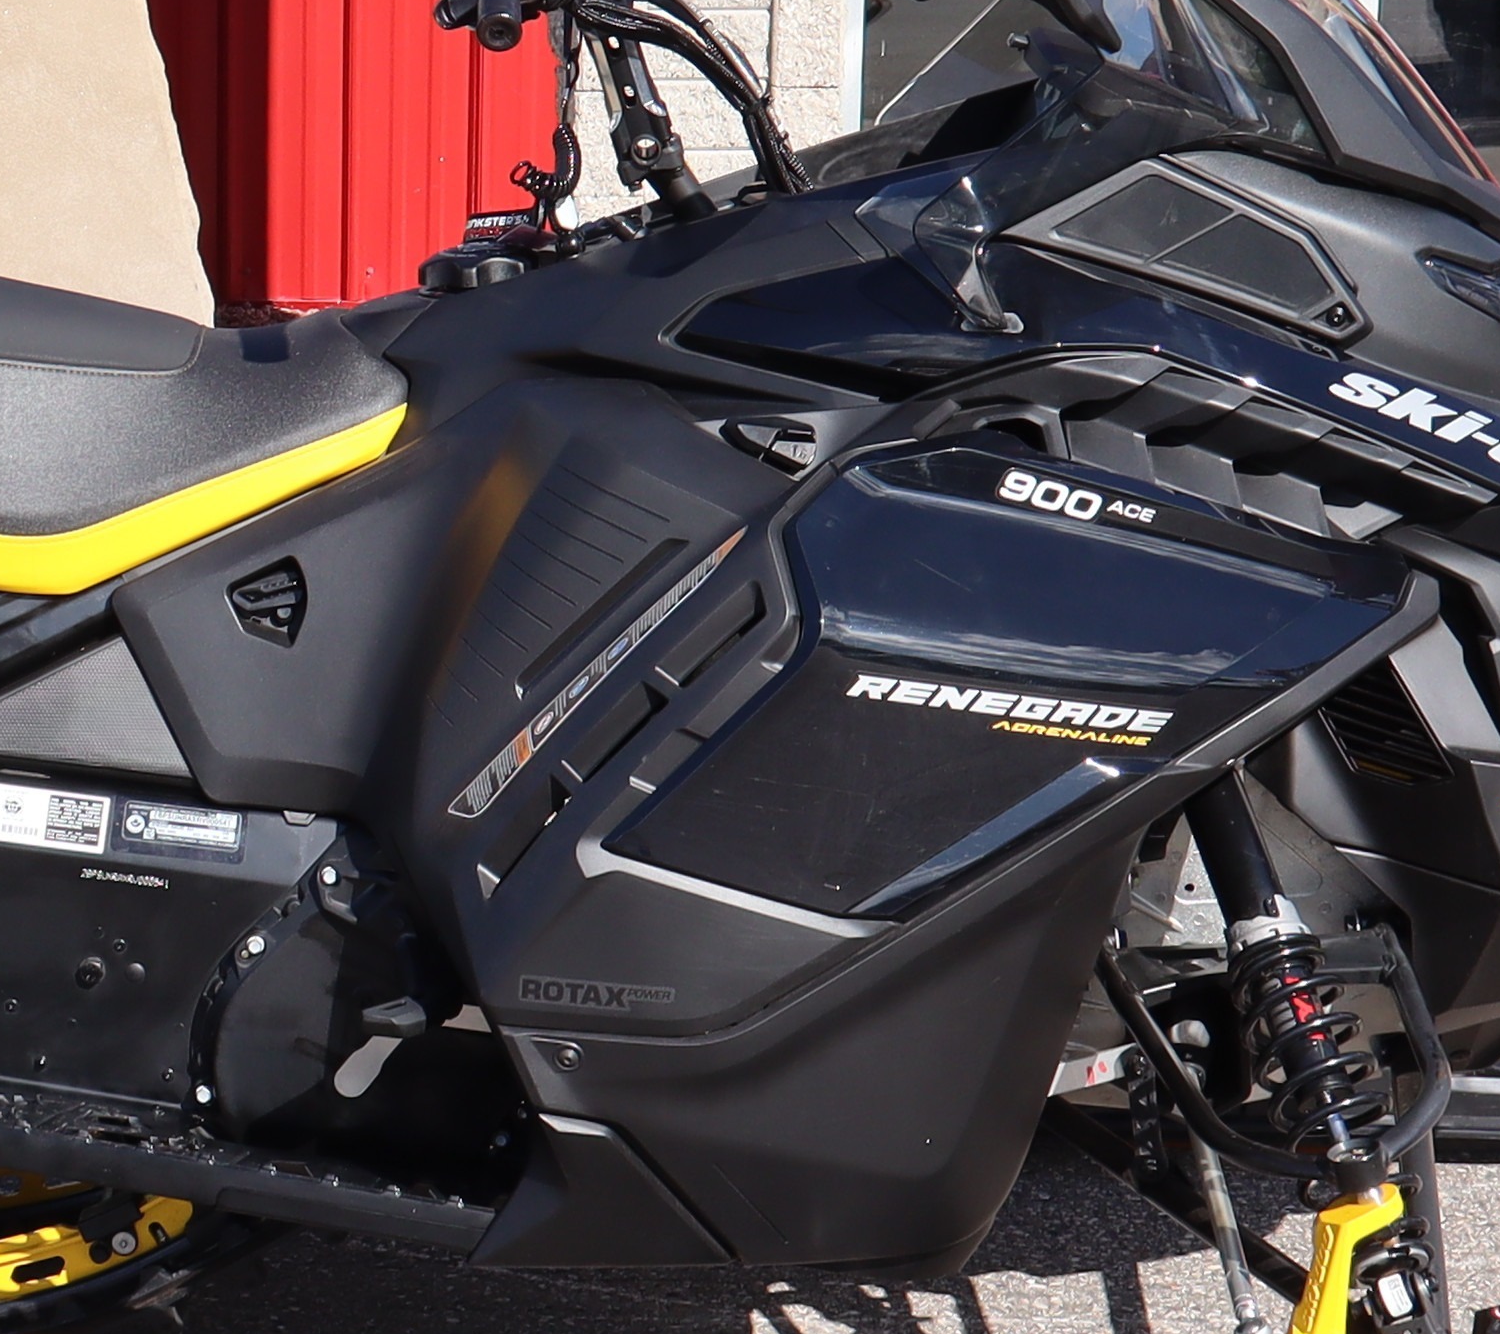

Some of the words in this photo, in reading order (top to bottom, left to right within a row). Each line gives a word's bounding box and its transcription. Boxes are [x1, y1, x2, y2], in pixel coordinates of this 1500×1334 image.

[1000, 471, 1102, 520] 900
[1106, 500, 1156, 523] ACE
[846, 673, 1174, 734] RENEGADE
[991, 720, 1152, 746] ADRENALINE
[521, 978, 626, 1008] ROTAX
[627, 988, 672, 1001] POWER
